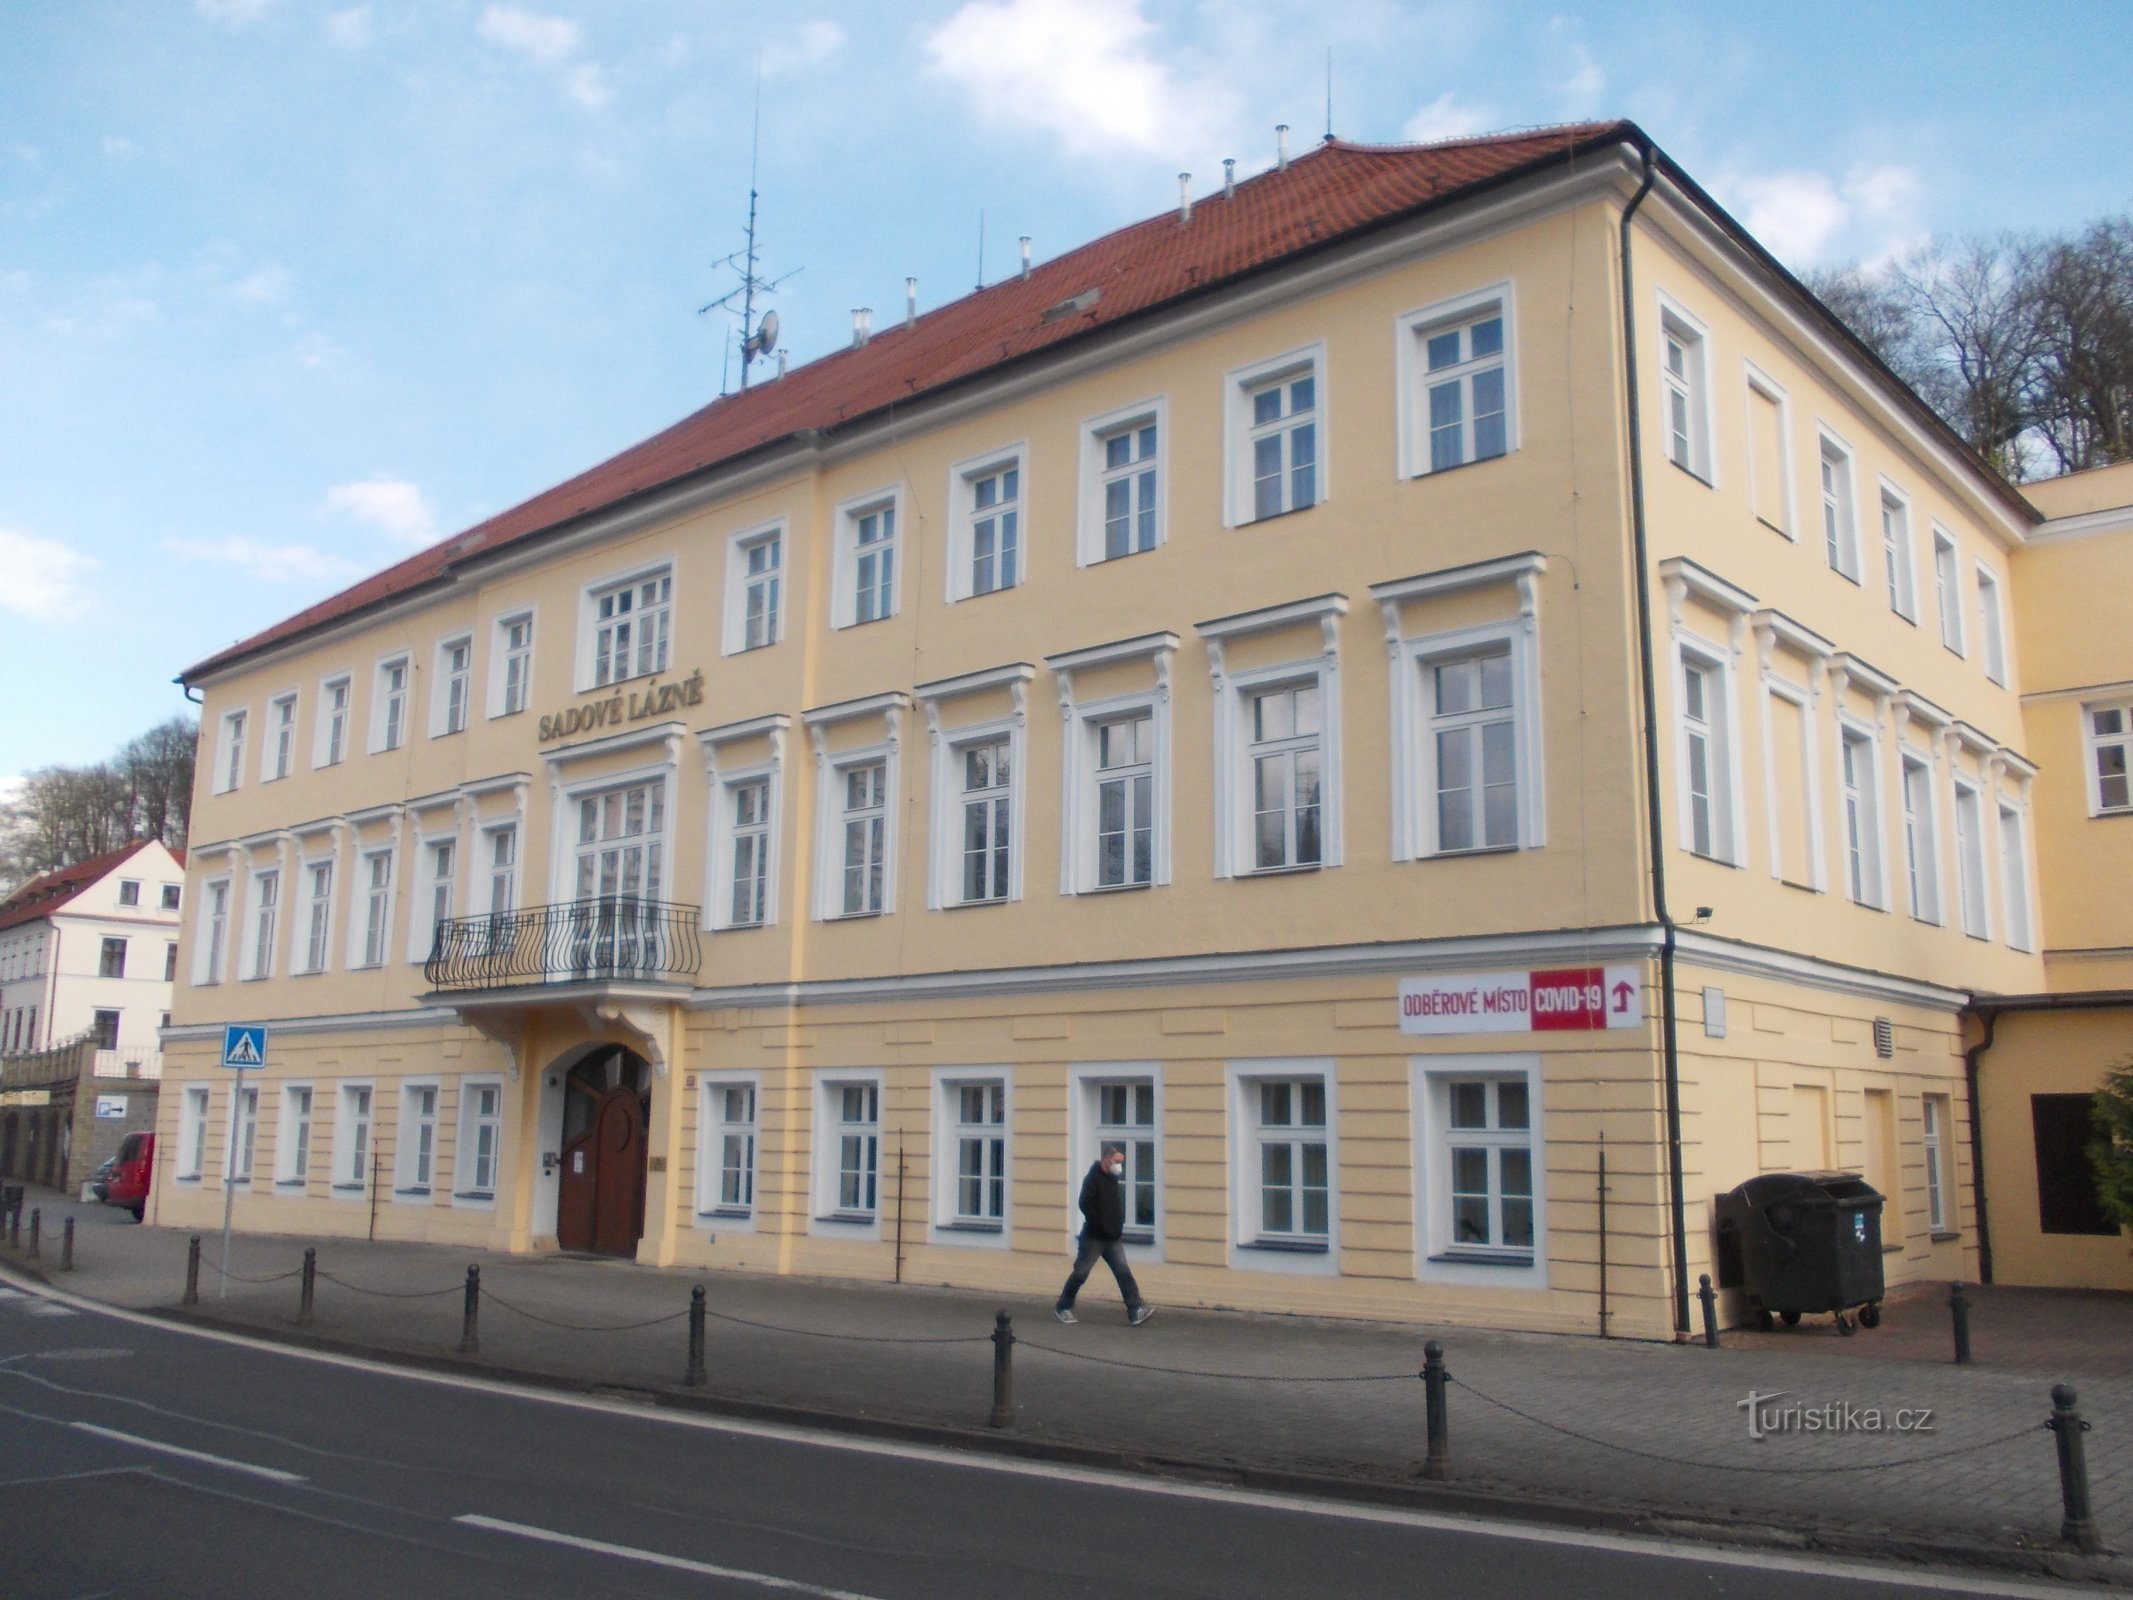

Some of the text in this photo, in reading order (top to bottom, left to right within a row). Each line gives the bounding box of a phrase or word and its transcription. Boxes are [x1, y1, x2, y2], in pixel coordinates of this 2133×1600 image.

[538, 667, 705, 742] SADOVÉ LÁZNĚ
[1403, 984, 1602, 1017] ODBĚROVÉ MÍSTO COVID-19
